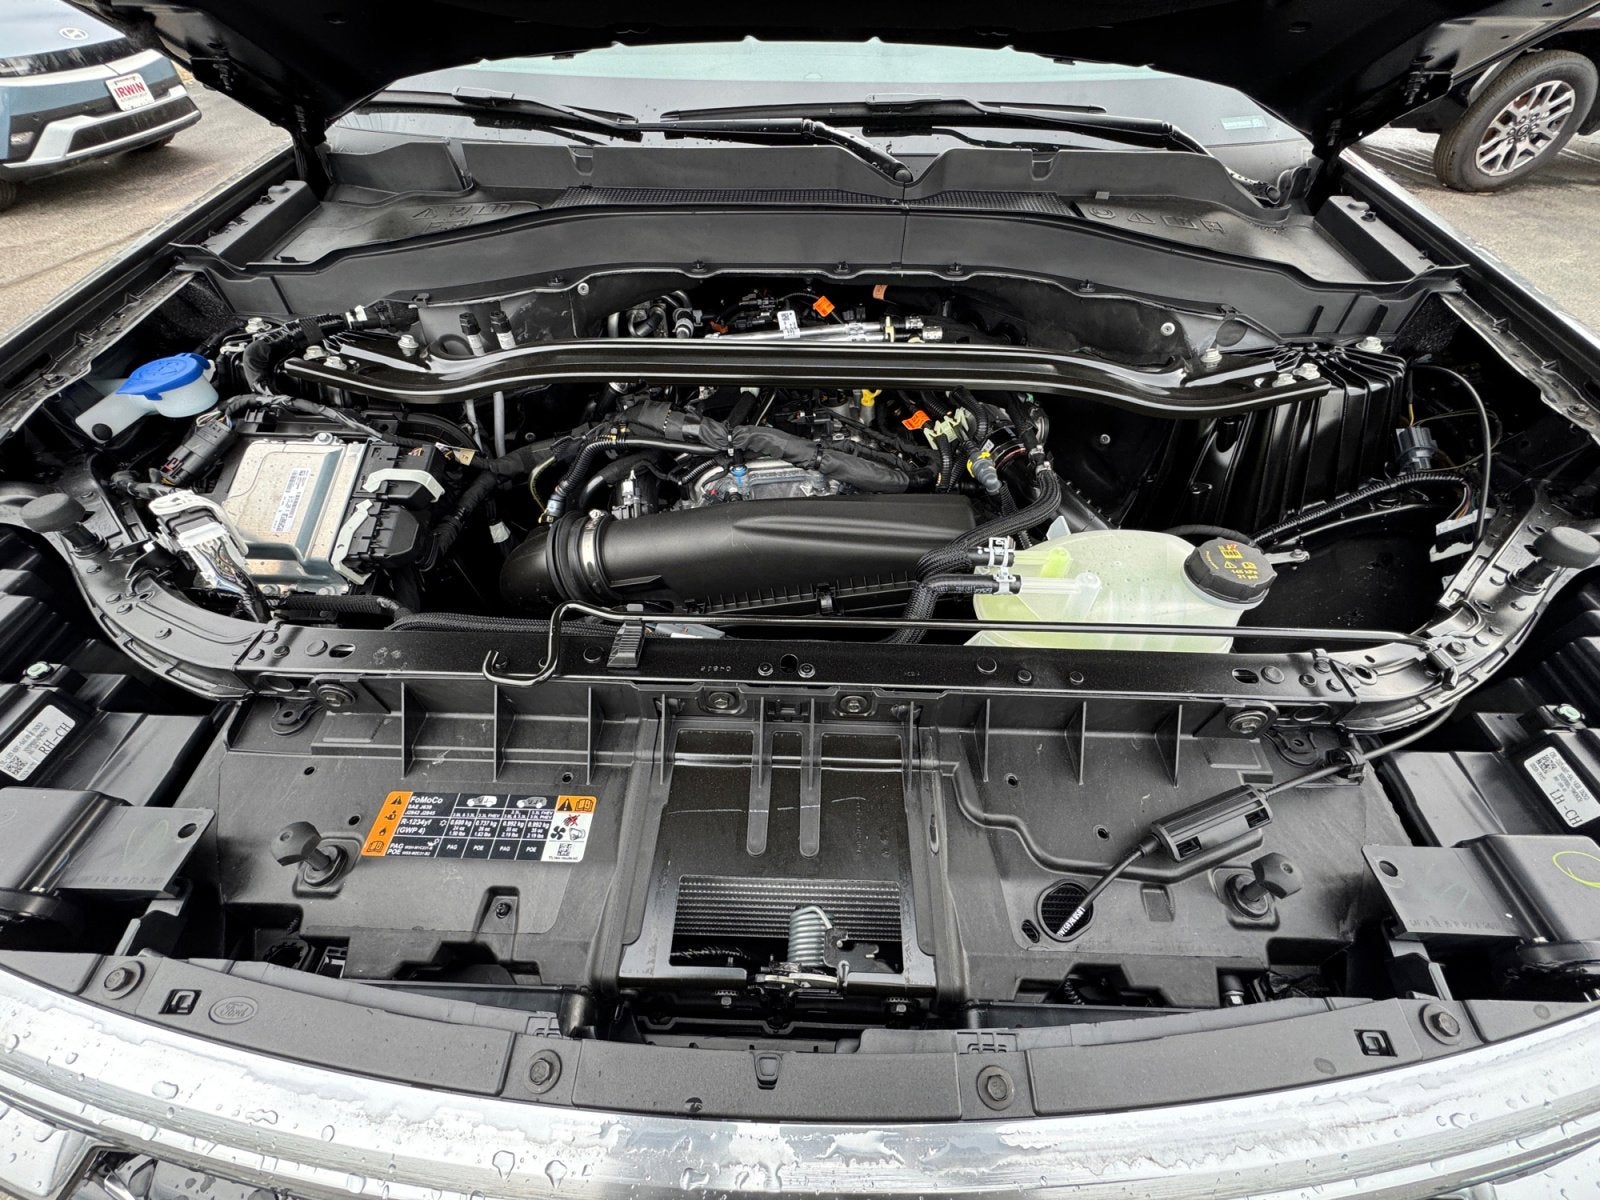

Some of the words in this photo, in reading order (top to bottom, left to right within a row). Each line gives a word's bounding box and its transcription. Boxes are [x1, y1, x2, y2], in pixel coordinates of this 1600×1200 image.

[113, 82, 146, 98] IRWIN
[409, 795, 444, 804] FoMoCo
[400, 818, 433, 827] R-1234yf
[465, 819, 473, 827] kg
[490, 820, 498, 828] kg
[517, 821, 525, 829] kg
[542, 822, 550, 830] kg
[396, 827, 417, 835] (GWP
[417, 827, 426, 835] 4)
[220, 1001, 249, 1017] Ford
